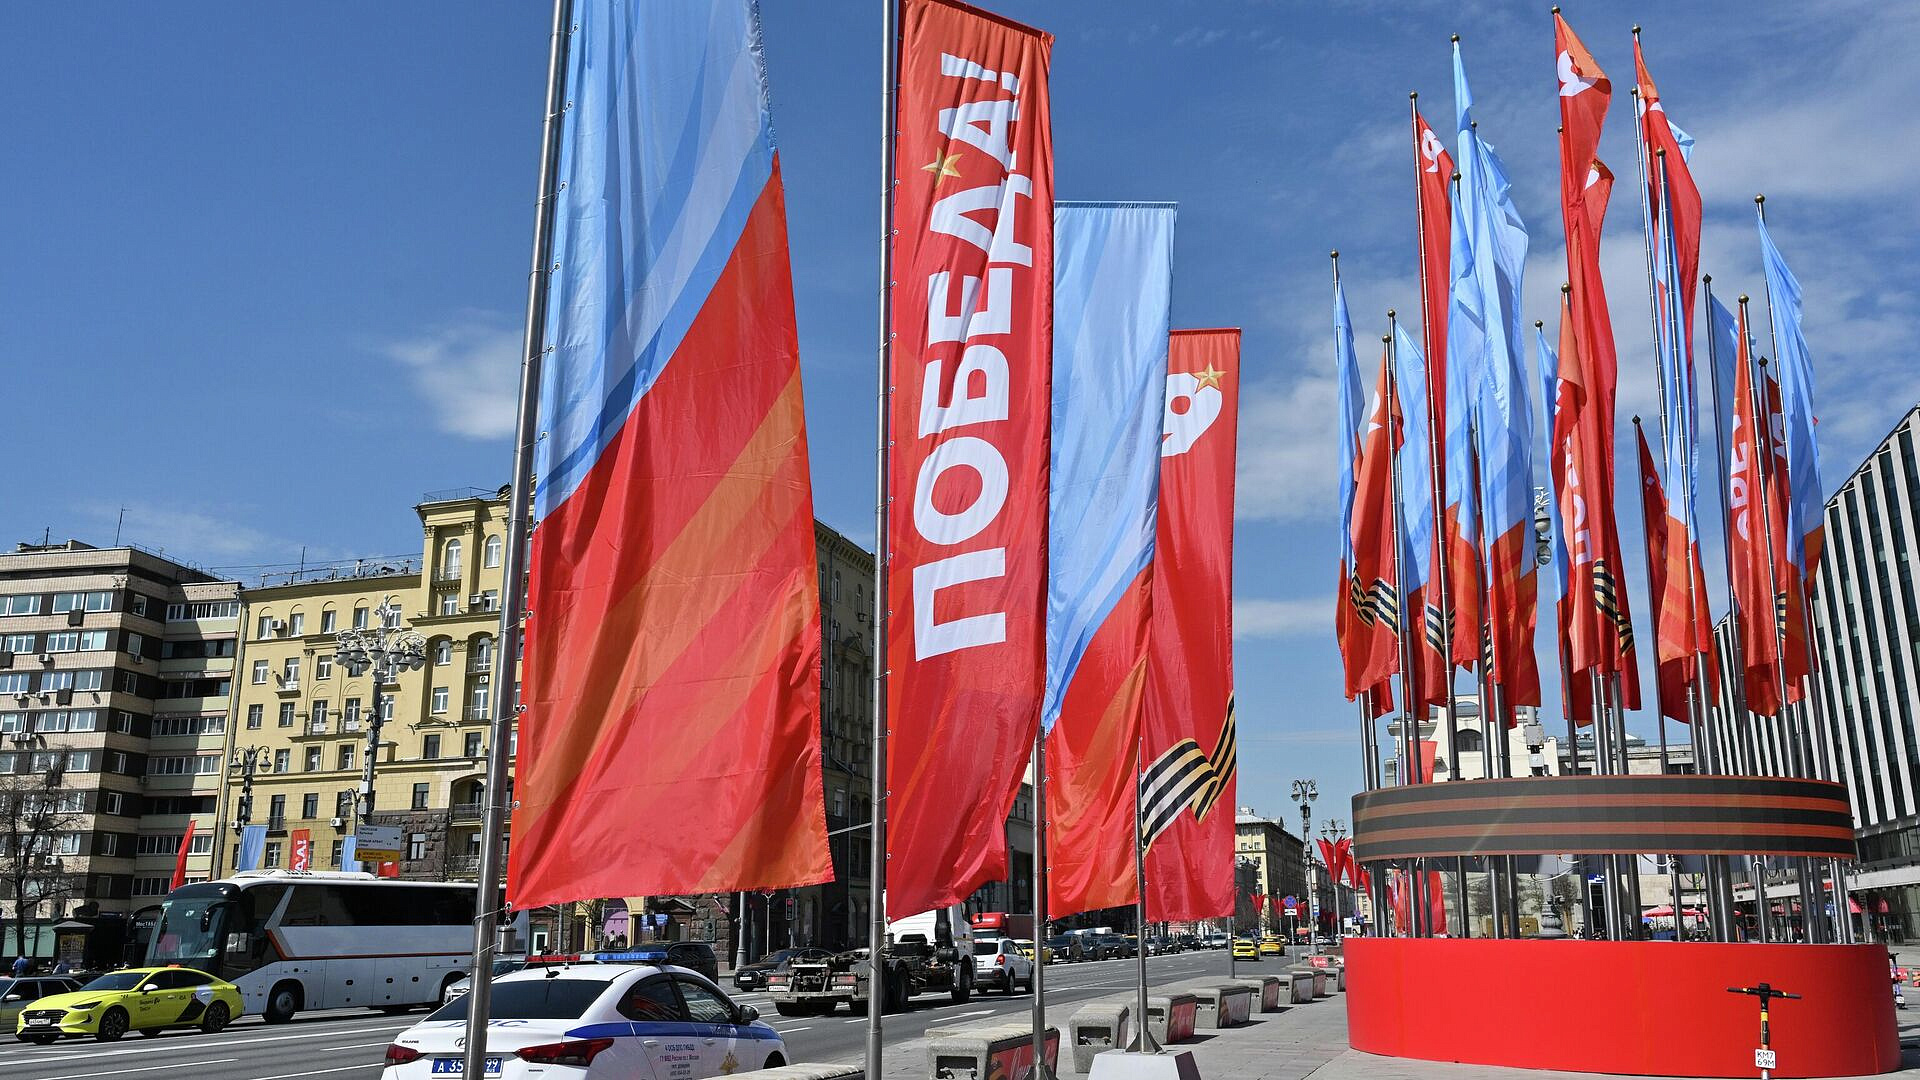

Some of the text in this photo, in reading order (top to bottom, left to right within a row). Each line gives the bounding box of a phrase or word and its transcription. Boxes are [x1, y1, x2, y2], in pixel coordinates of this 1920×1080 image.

[912, 51, 1033, 662] ПОБЕДА!
[1161, 372, 1223, 458] 9
[437, 1062, 444, 1072] А
[486, 1059, 498, 1068] 99
